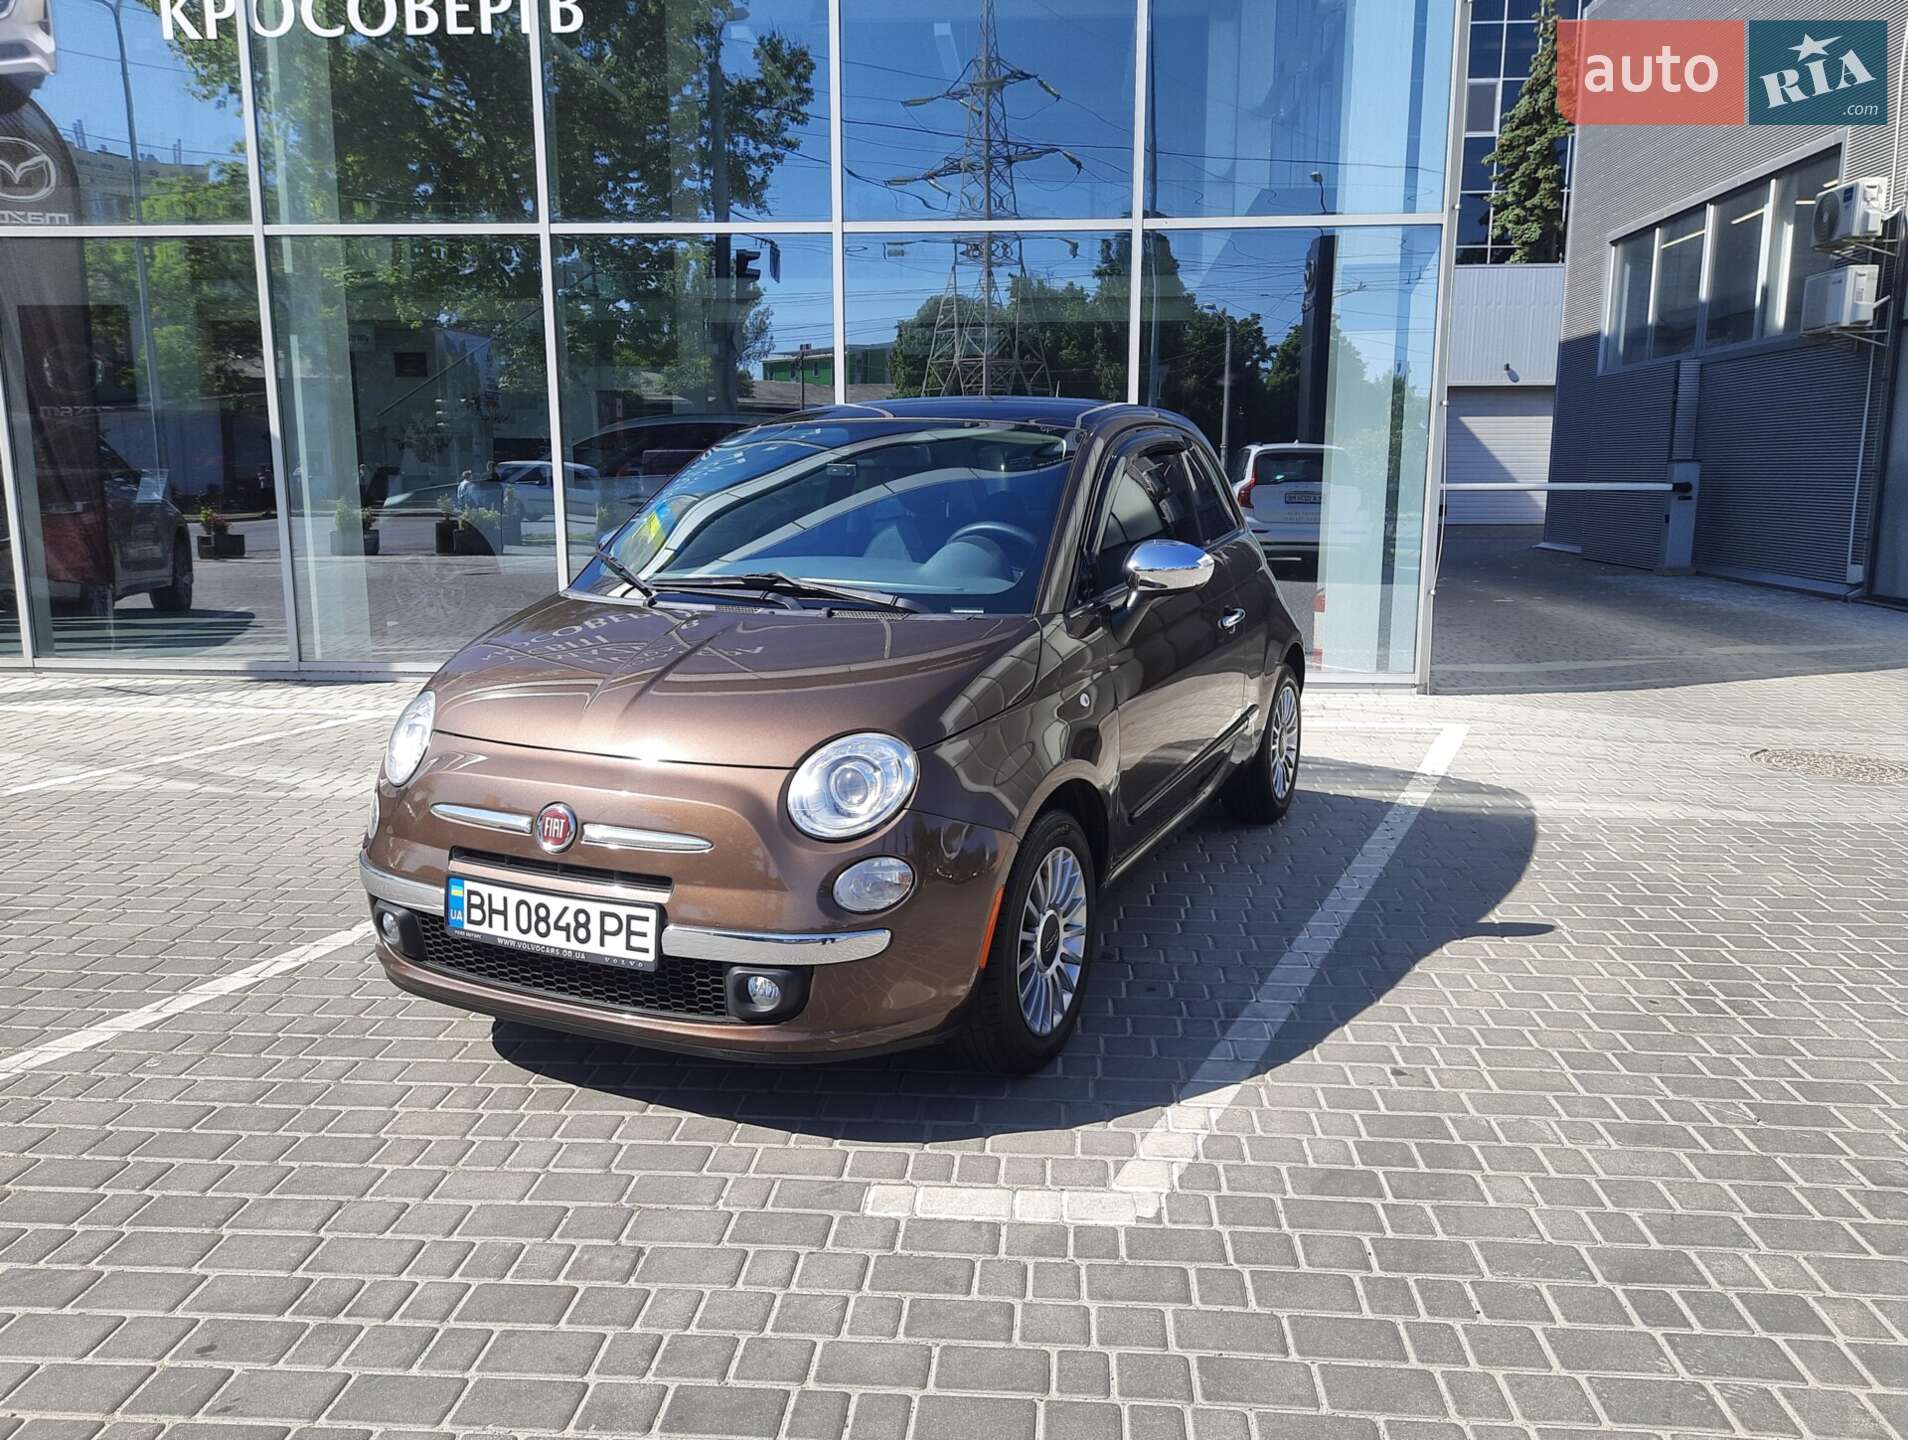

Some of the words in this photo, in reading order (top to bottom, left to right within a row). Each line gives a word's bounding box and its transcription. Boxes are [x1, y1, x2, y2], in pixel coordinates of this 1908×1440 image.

[543, 816, 565, 839] FIAT
[450, 909, 463, 922] UA
[515, 898, 591, 945] 0848
